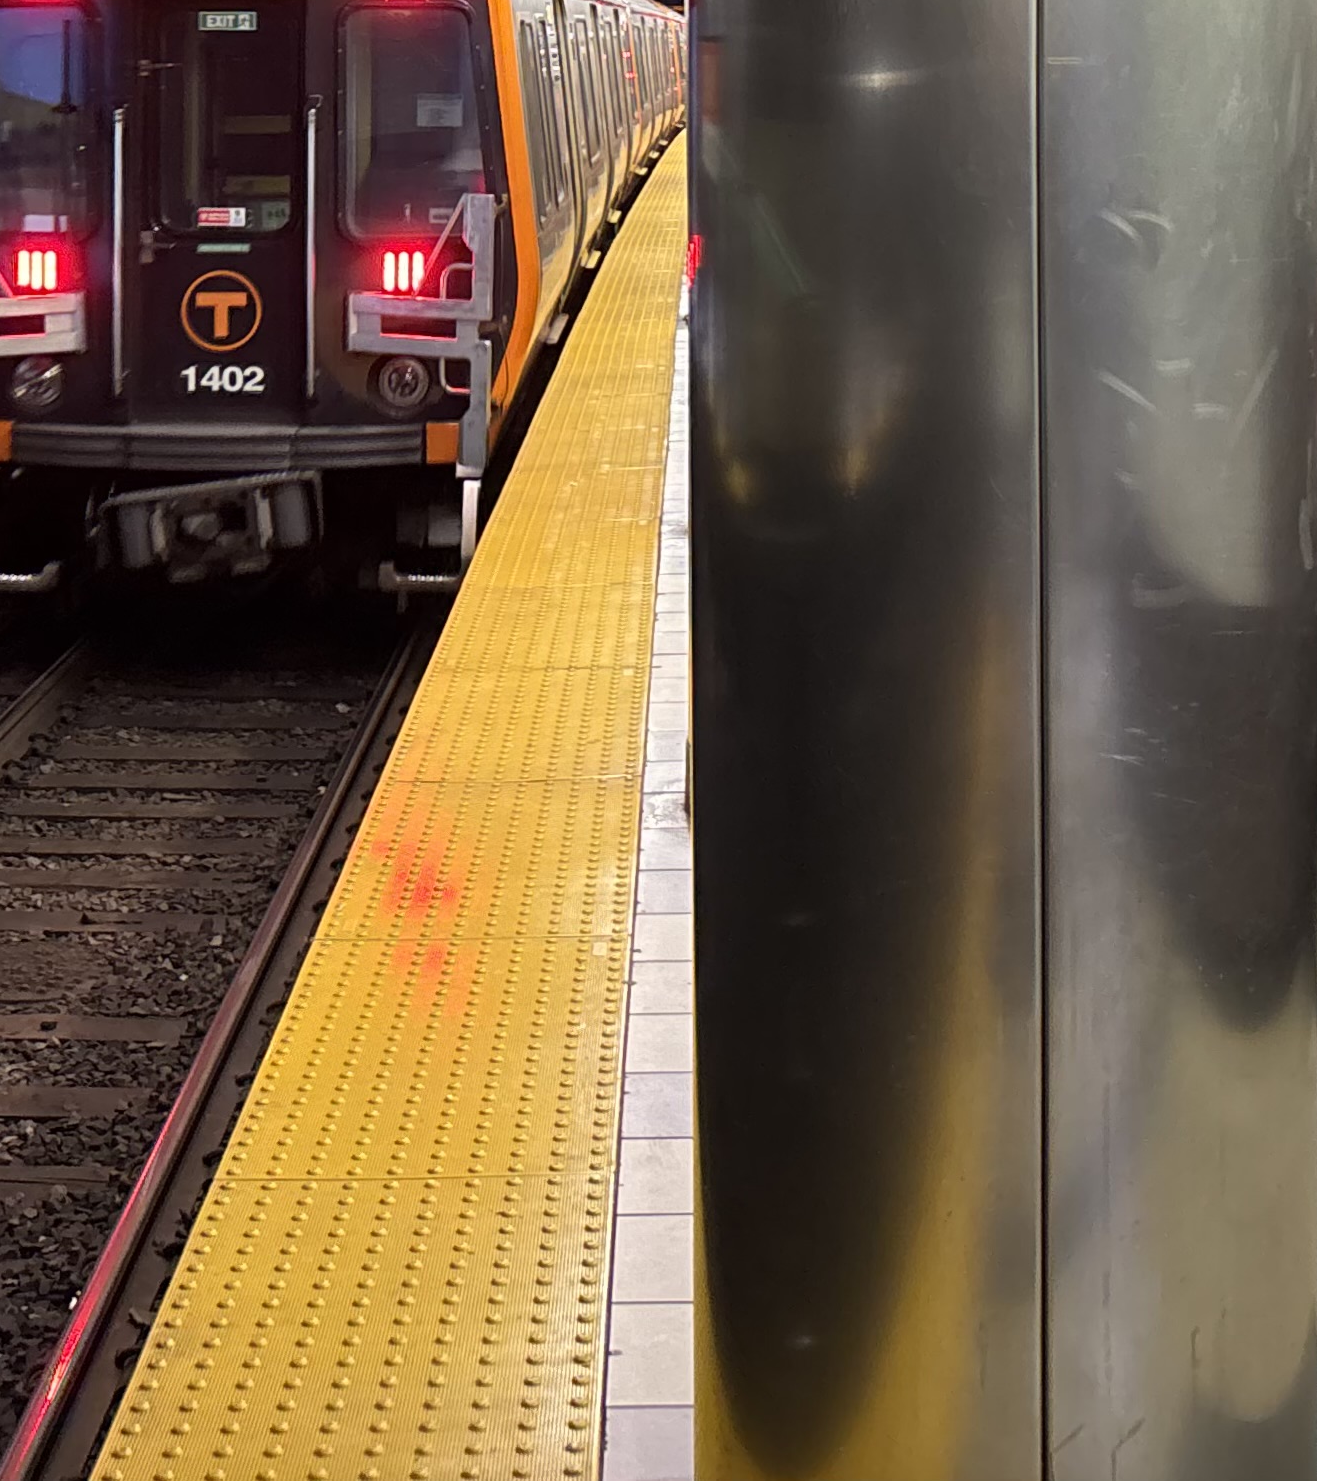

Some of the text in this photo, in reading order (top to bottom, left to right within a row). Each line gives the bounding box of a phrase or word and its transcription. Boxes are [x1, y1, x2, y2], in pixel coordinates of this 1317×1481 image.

[206, 14, 235, 27] EXIT
[195, 292, 248, 339] T
[180, 365, 265, 392] 1402
